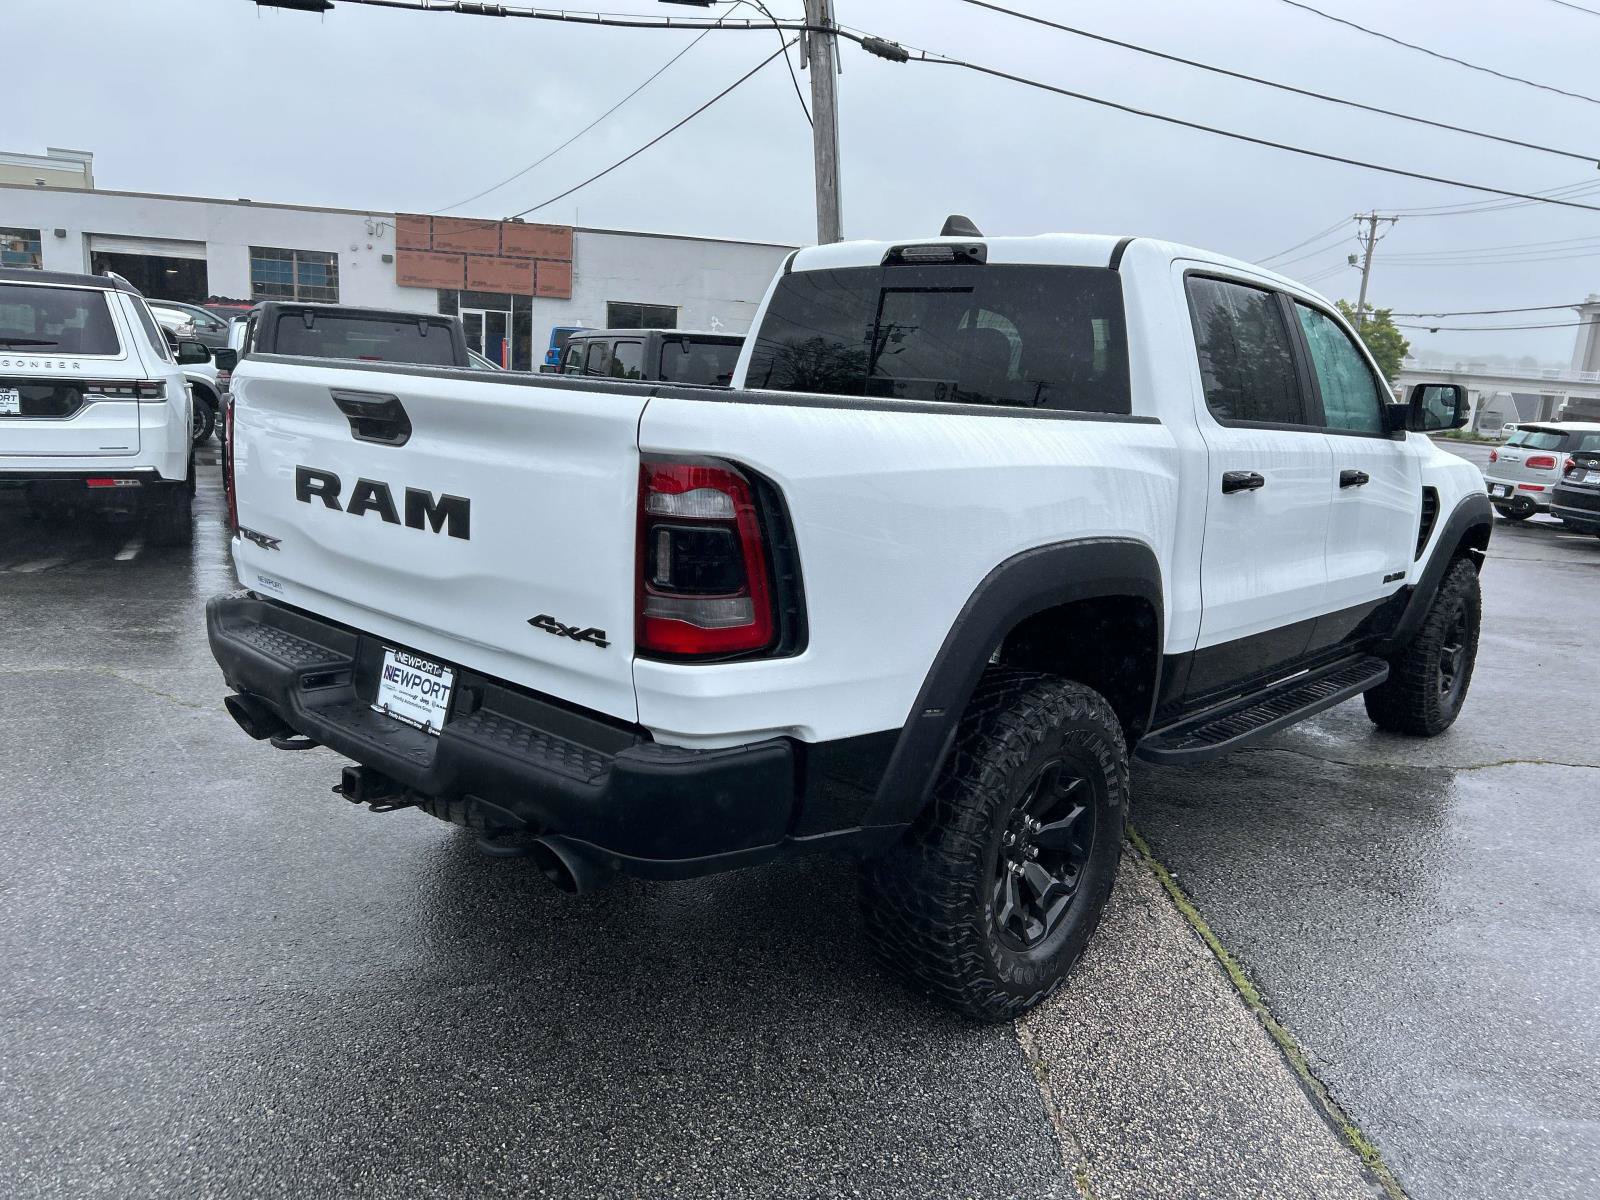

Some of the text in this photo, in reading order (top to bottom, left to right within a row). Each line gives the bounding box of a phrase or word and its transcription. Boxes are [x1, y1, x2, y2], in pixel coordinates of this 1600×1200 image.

[295, 464, 471, 541] RAM
[397, 652, 438, 674] NEWPORT
[383, 664, 450, 700] NEWPORT
